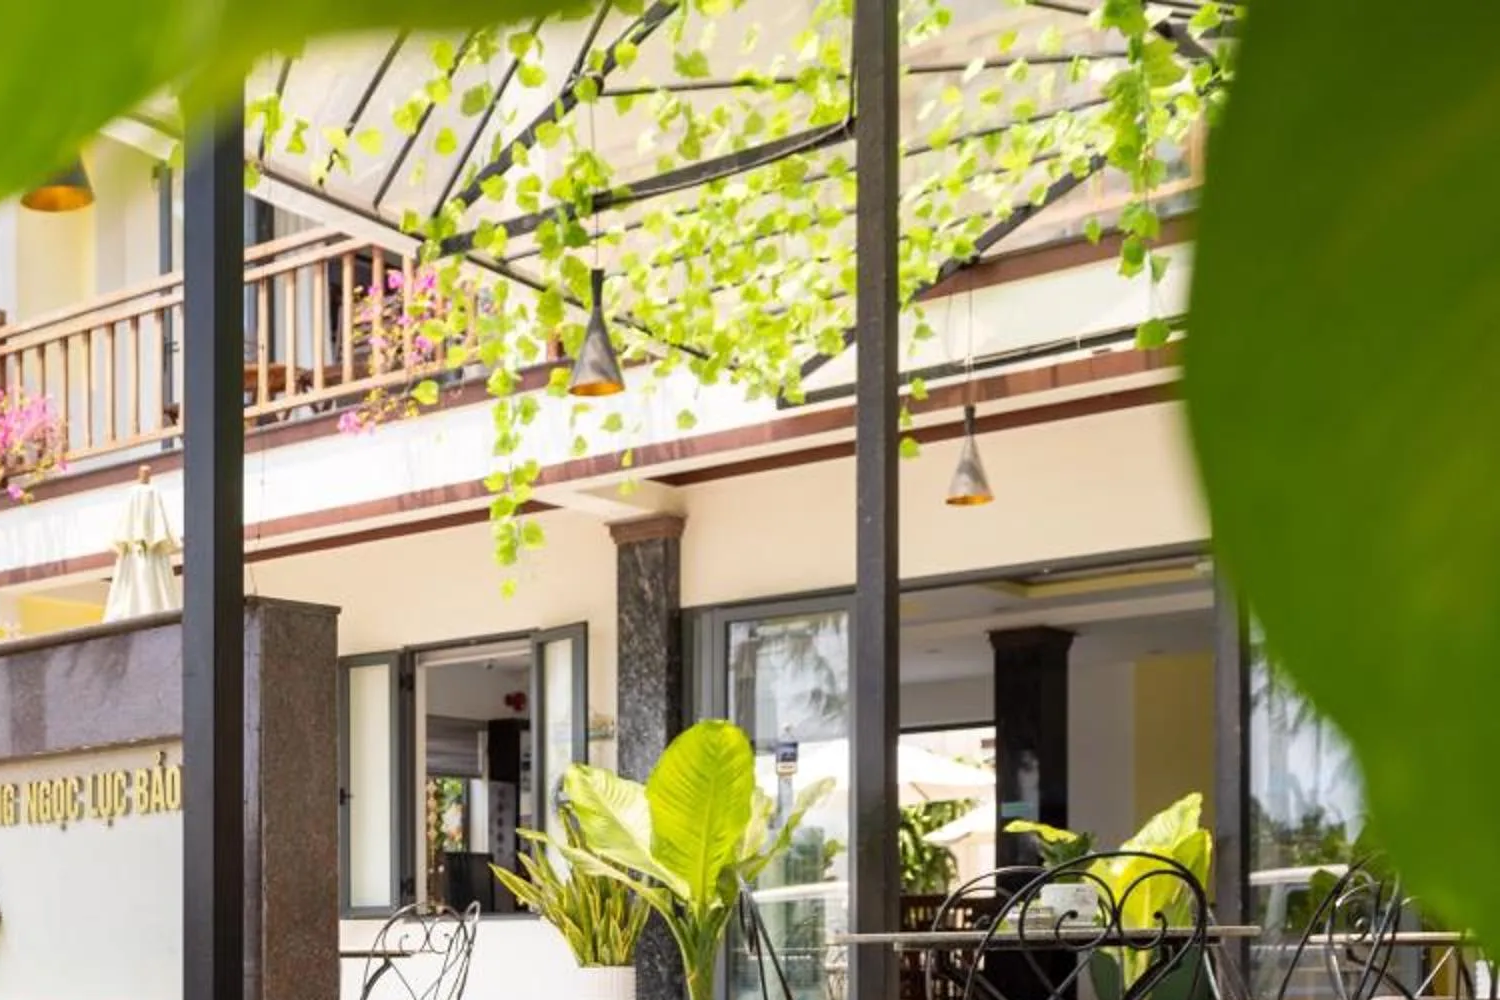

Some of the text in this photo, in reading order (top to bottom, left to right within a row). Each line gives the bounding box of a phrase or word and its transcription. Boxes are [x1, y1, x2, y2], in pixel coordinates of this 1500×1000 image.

[24, 775, 81, 831] NGỌC
[86, 768, 128, 828] LỤC
[134, 752, 182, 817] BẢO
